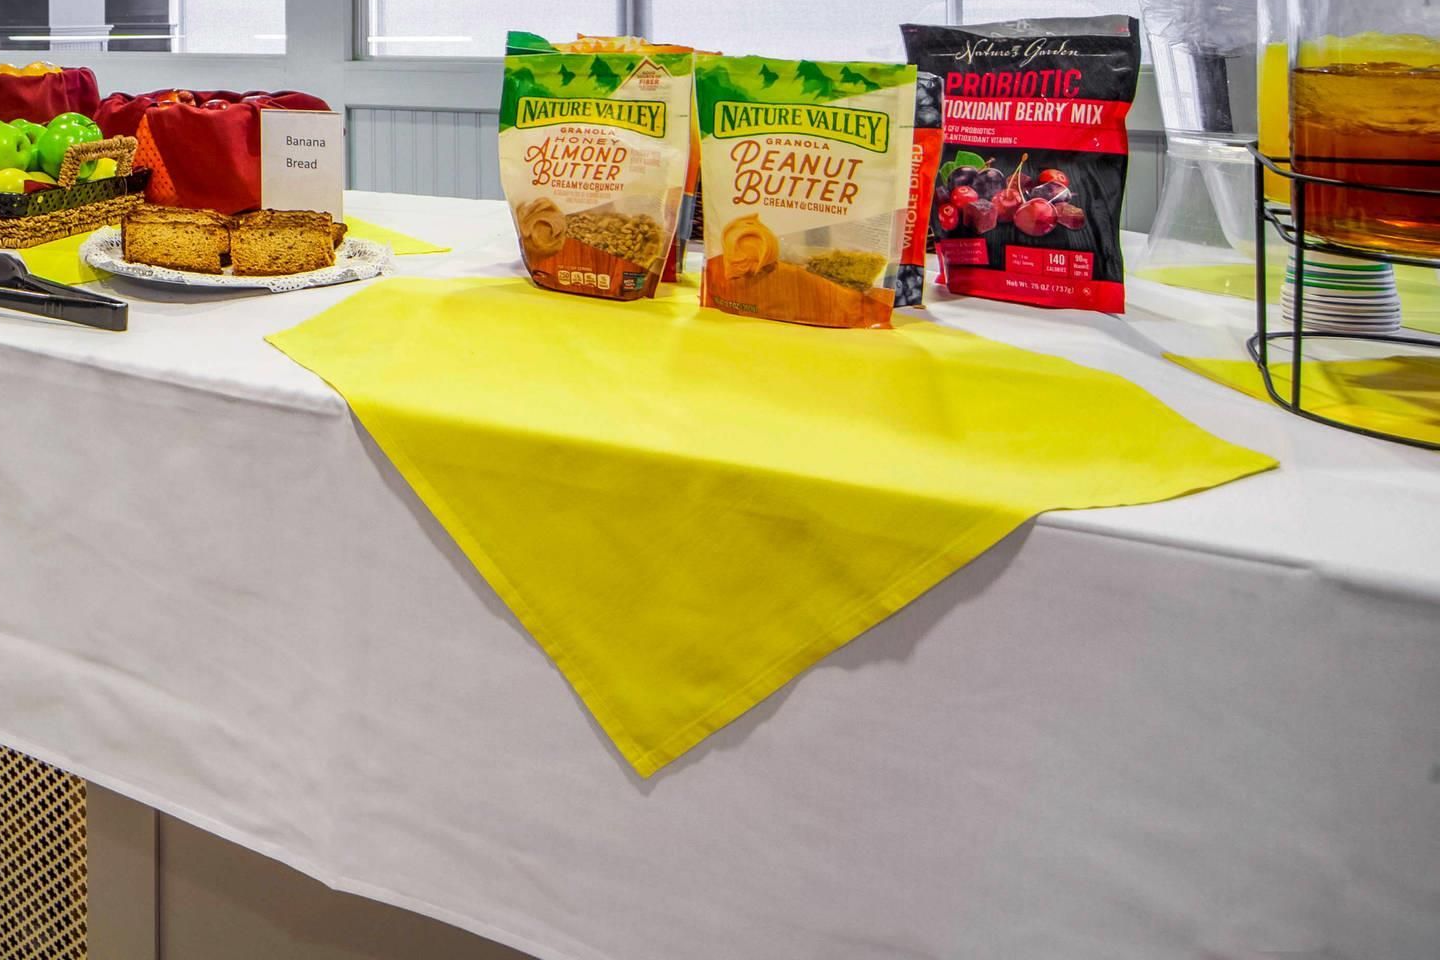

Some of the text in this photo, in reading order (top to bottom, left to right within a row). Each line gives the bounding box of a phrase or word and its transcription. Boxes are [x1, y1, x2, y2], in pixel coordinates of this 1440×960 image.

[1020, 37, 1080, 68] Garden
[946, 68, 1083, 98] PROBIOTIC
[522, 100, 661, 132] NATURE VALLEY
[720, 104, 882, 146] NATURE VALLEY
[943, 99, 1104, 125] TIOXIDANT BERRY MIX
[286, 135, 326, 148] Banana
[554, 136, 620, 146] HONEY
[560, 126, 616, 136] GRANOLA
[960, 126, 996, 135] PROBIOTICS
[524, 137, 628, 164] ALMOND
[765, 138, 831, 151] GRANOLA
[286, 157, 318, 169] Bread
[532, 159, 620, 186] BUTTER
[730, 140, 864, 180] PEANUT
[732, 169, 858, 205] BUTTER
[902, 143, 924, 249] WHOLE DRIED
[763, 197, 798, 209] CREAMY
[807, 202, 848, 215] CRUNCHY
[1049, 253, 1065, 266] 140
